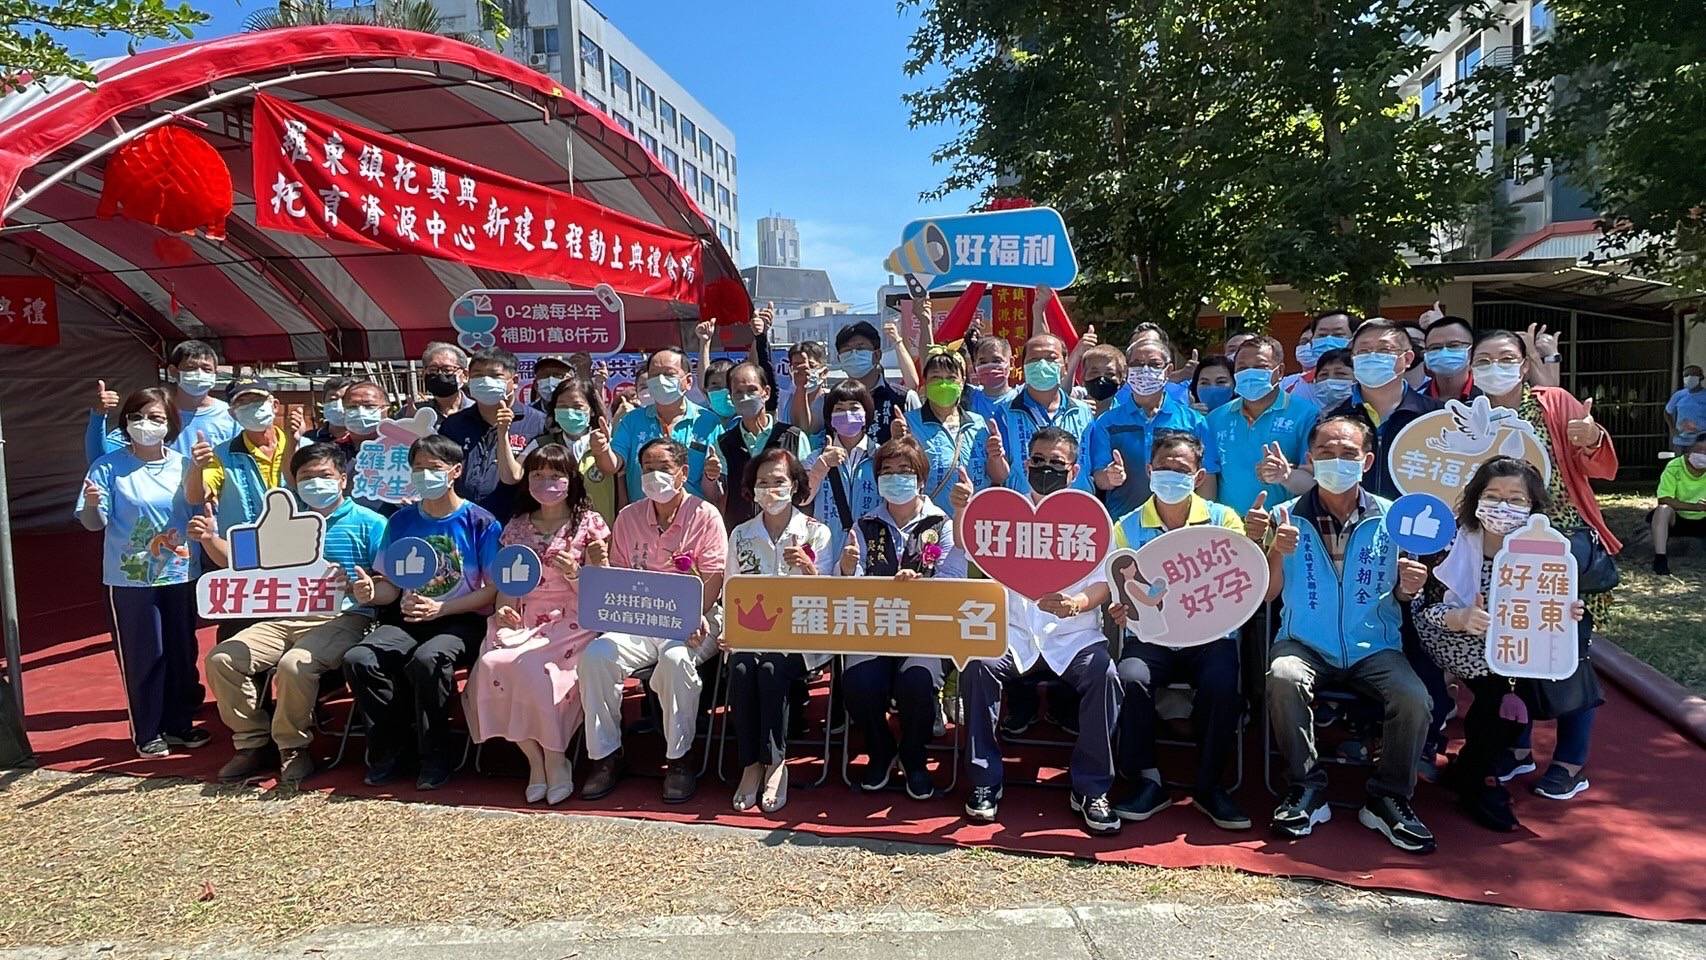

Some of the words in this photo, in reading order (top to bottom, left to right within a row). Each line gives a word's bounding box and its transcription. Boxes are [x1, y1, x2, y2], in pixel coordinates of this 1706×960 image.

[955, 234, 1055, 267] 好福利
[504, 303, 602, 321] 0-2歲每半年
[501, 326, 609, 344] 補助1萬8仟元
[357, 445, 409, 471] 羅東
[1397, 449, 1480, 488] 幸福
[354, 475, 417, 497] 好生
[974, 519, 1097, 563] 好服務
[1161, 537, 1239, 585] 助妳
[208, 577, 338, 615] 好生活
[604, 592, 678, 612] 公共托育中心
[1178, 566, 1253, 619] 好孕
[1536, 562, 1570, 632] 羅東
[791, 596, 997, 641] 羅東第一名
[1495, 562, 1533, 665] 好福利
